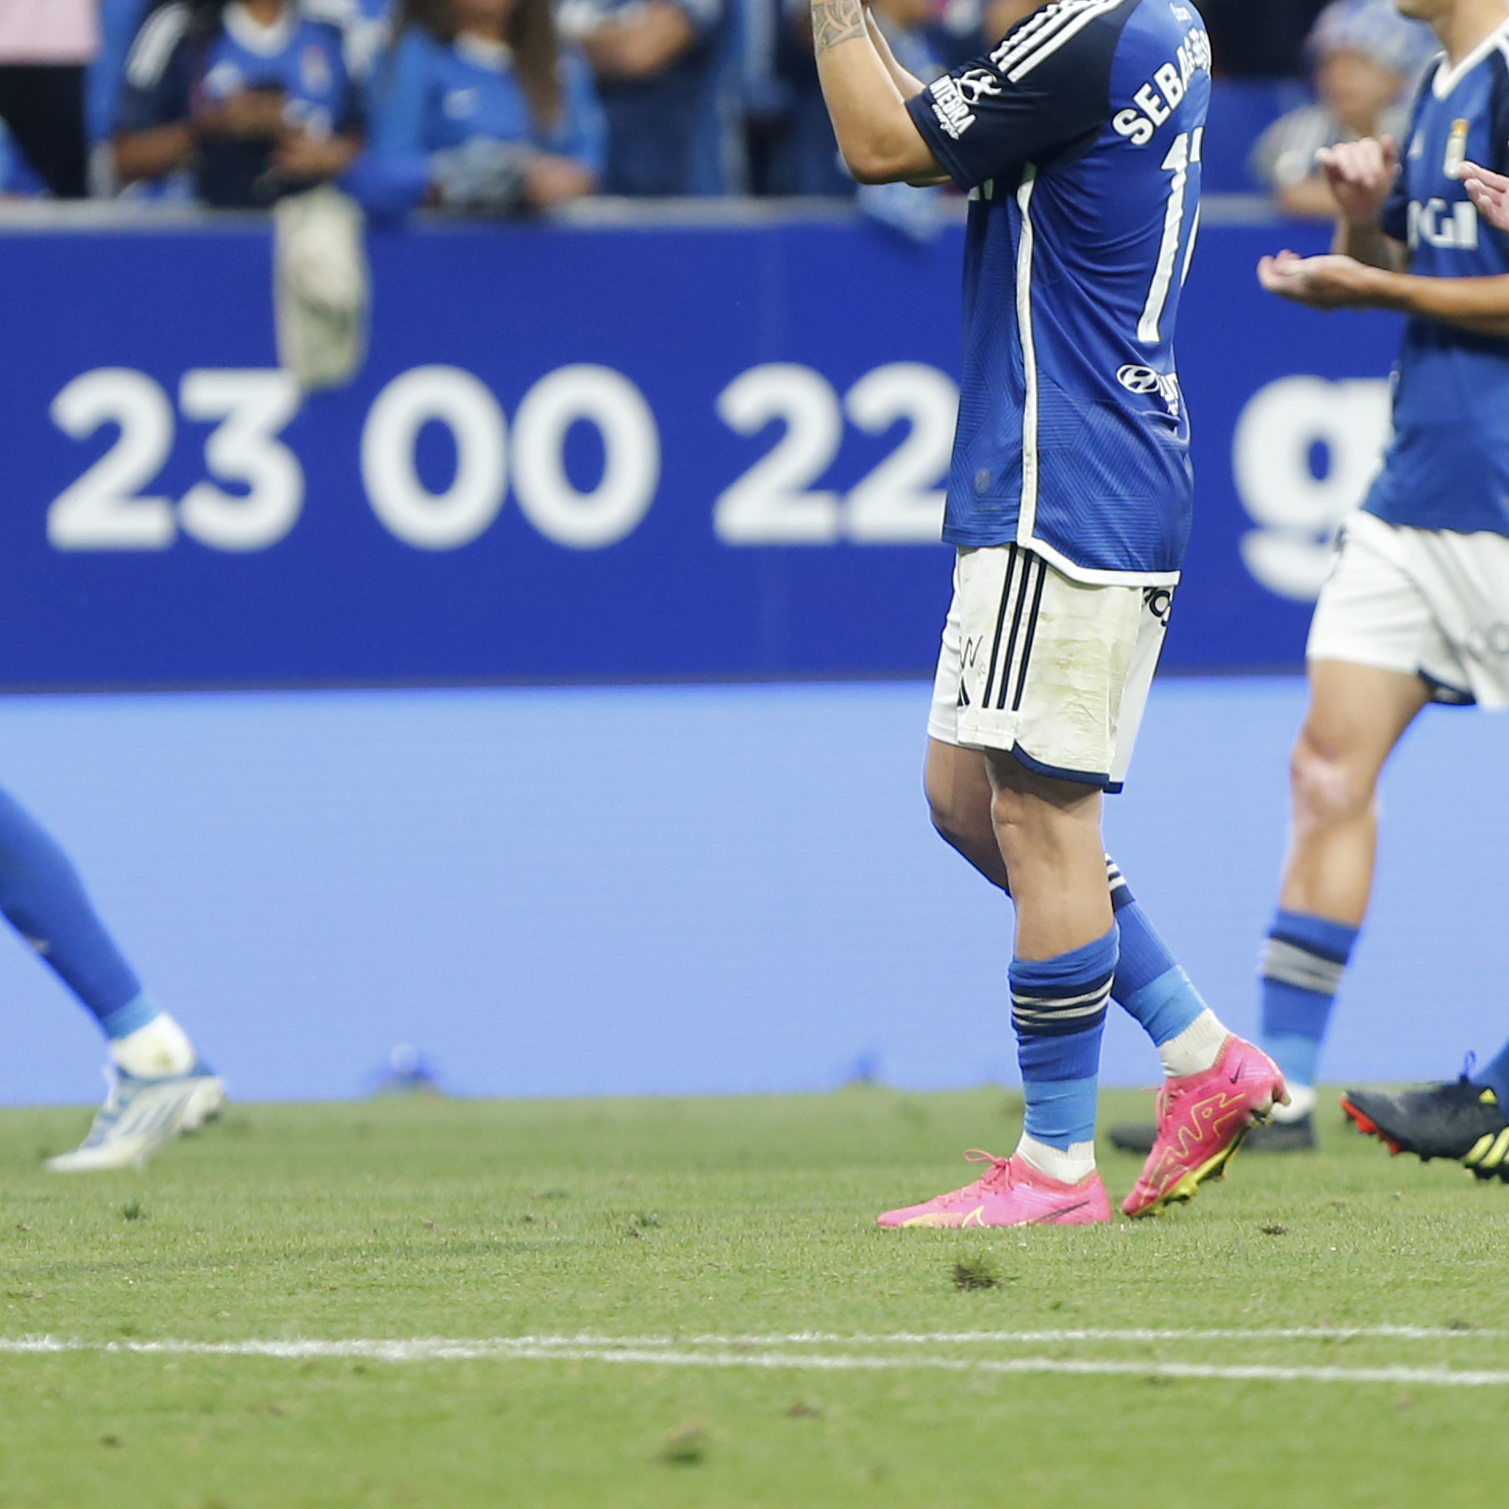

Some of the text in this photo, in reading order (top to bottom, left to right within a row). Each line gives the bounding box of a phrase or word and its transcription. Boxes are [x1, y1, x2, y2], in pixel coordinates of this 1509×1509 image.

[48, 367, 305, 551] 23
[360, 363, 661, 549] 00
[713, 361, 961, 544] 22
